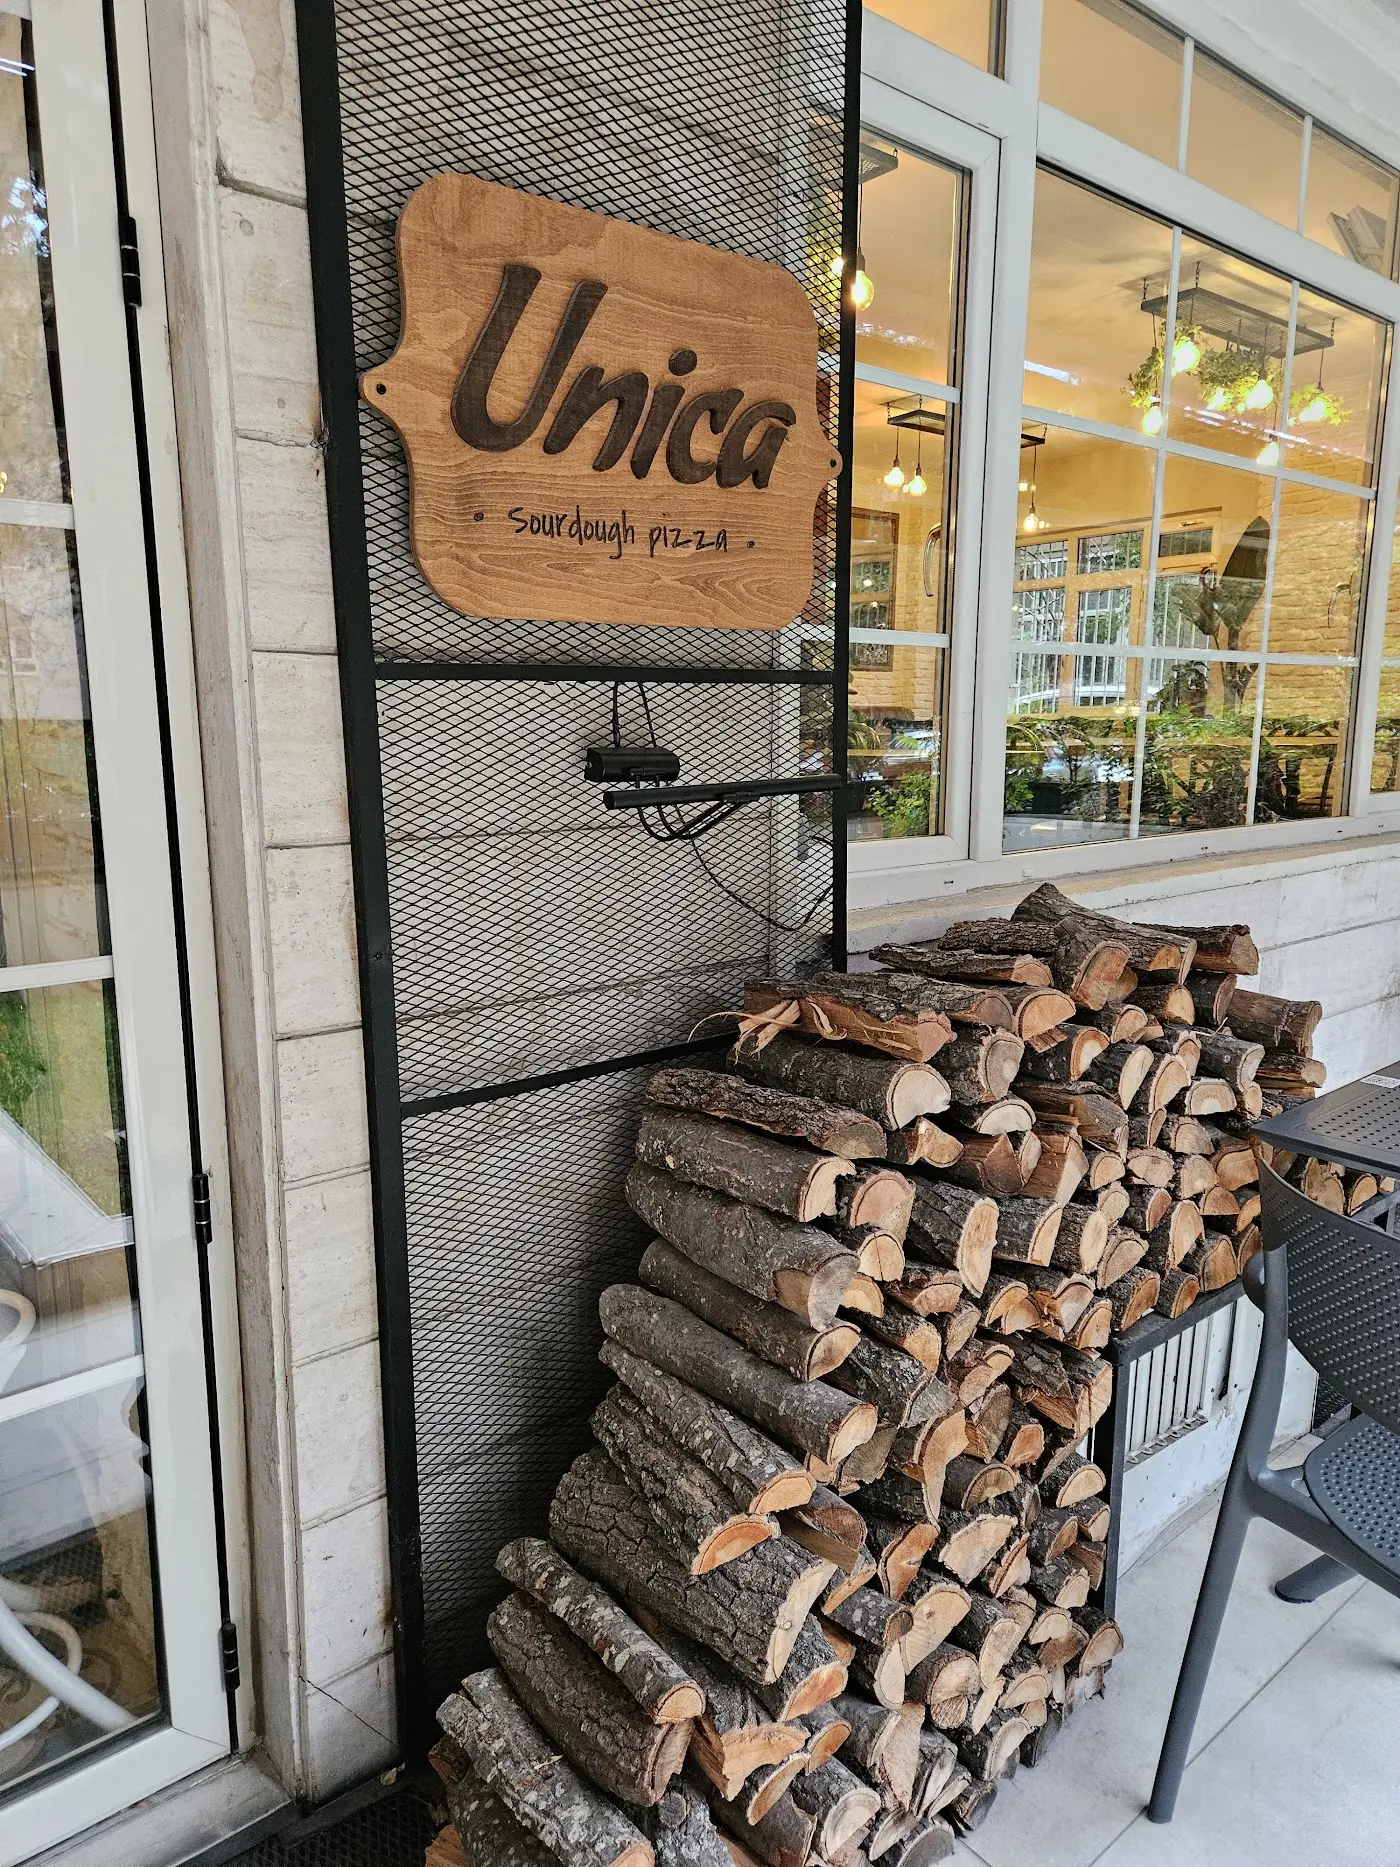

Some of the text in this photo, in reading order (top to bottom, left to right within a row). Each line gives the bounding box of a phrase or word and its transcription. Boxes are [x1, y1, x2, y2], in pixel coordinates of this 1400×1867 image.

[450, 265, 796, 489] Unica
[508, 504, 728, 560] Sourdough pizza
